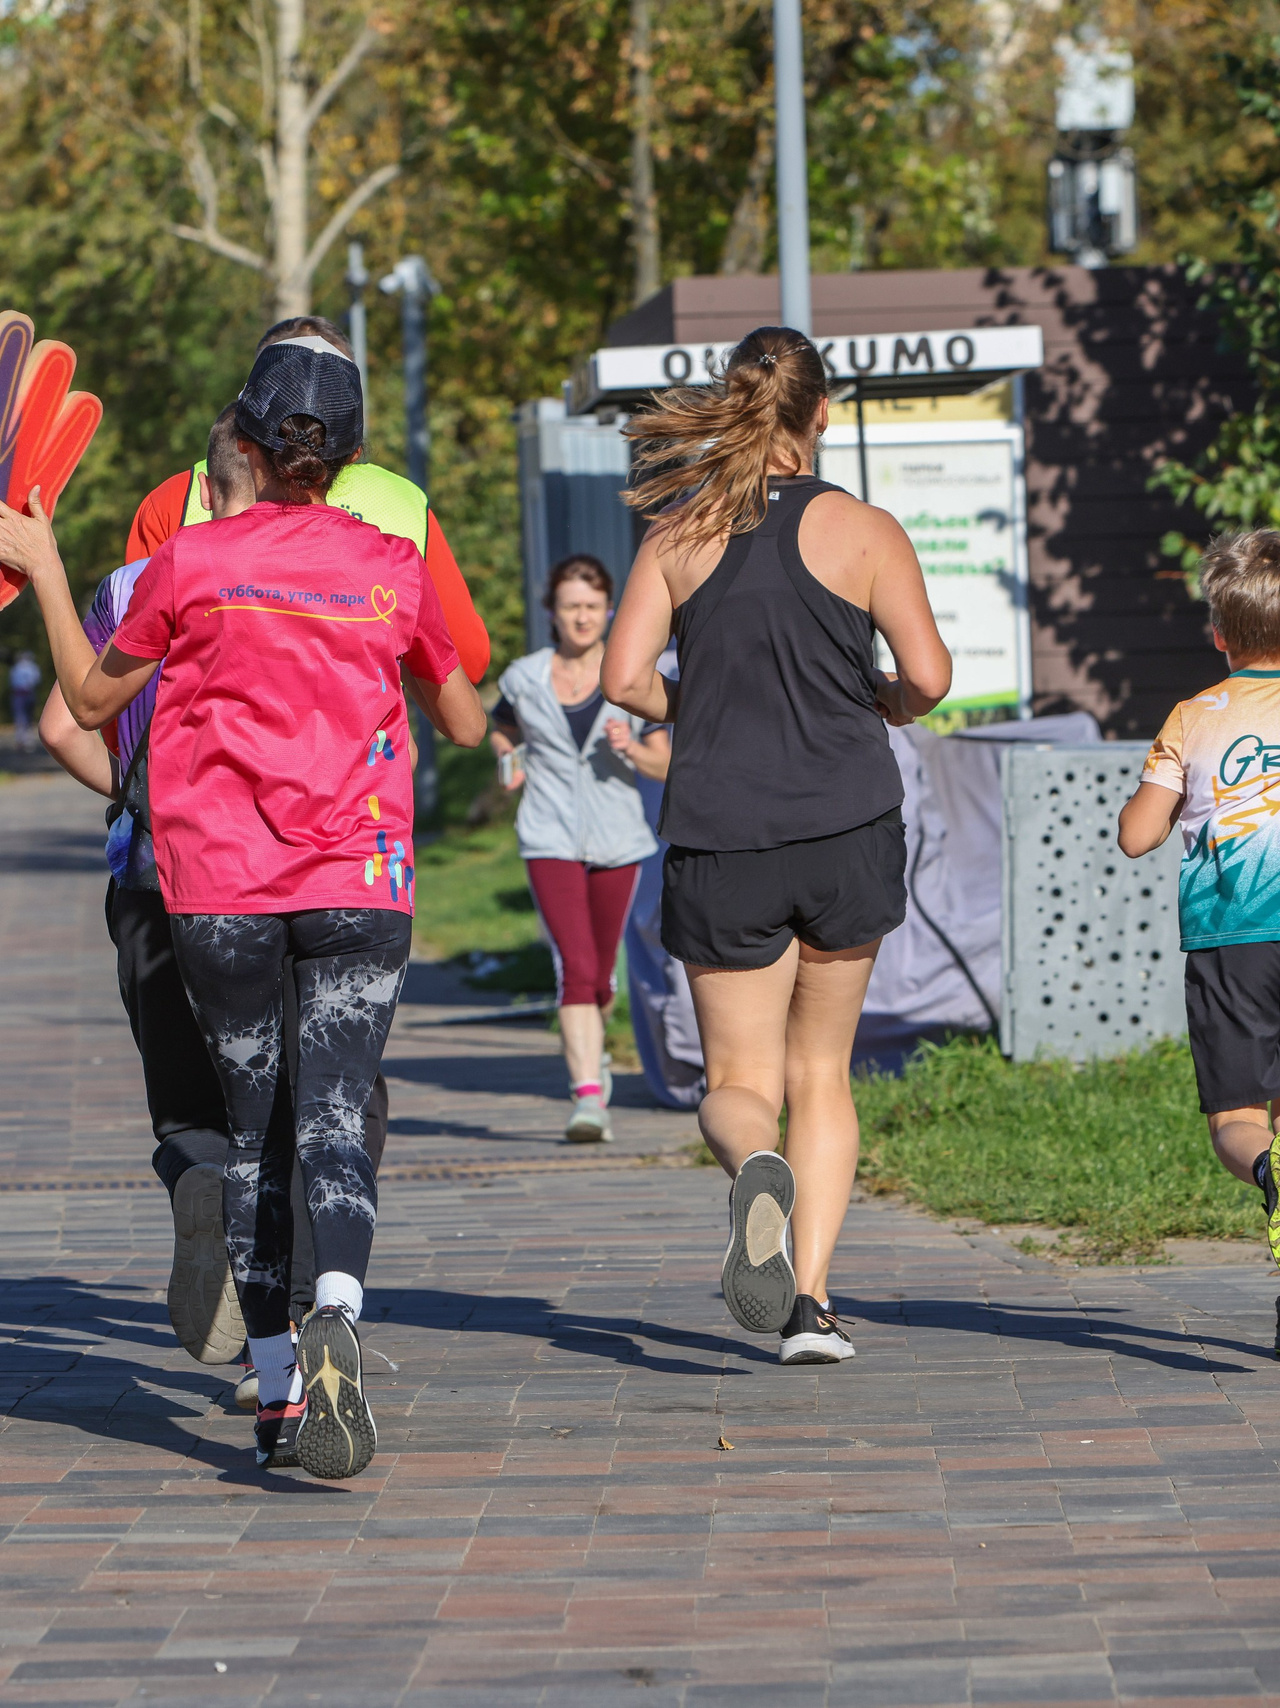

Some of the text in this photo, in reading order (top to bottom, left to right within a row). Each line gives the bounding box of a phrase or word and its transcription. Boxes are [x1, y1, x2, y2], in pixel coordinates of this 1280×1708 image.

[218, 584, 366, 607] суббота, утро, парк
